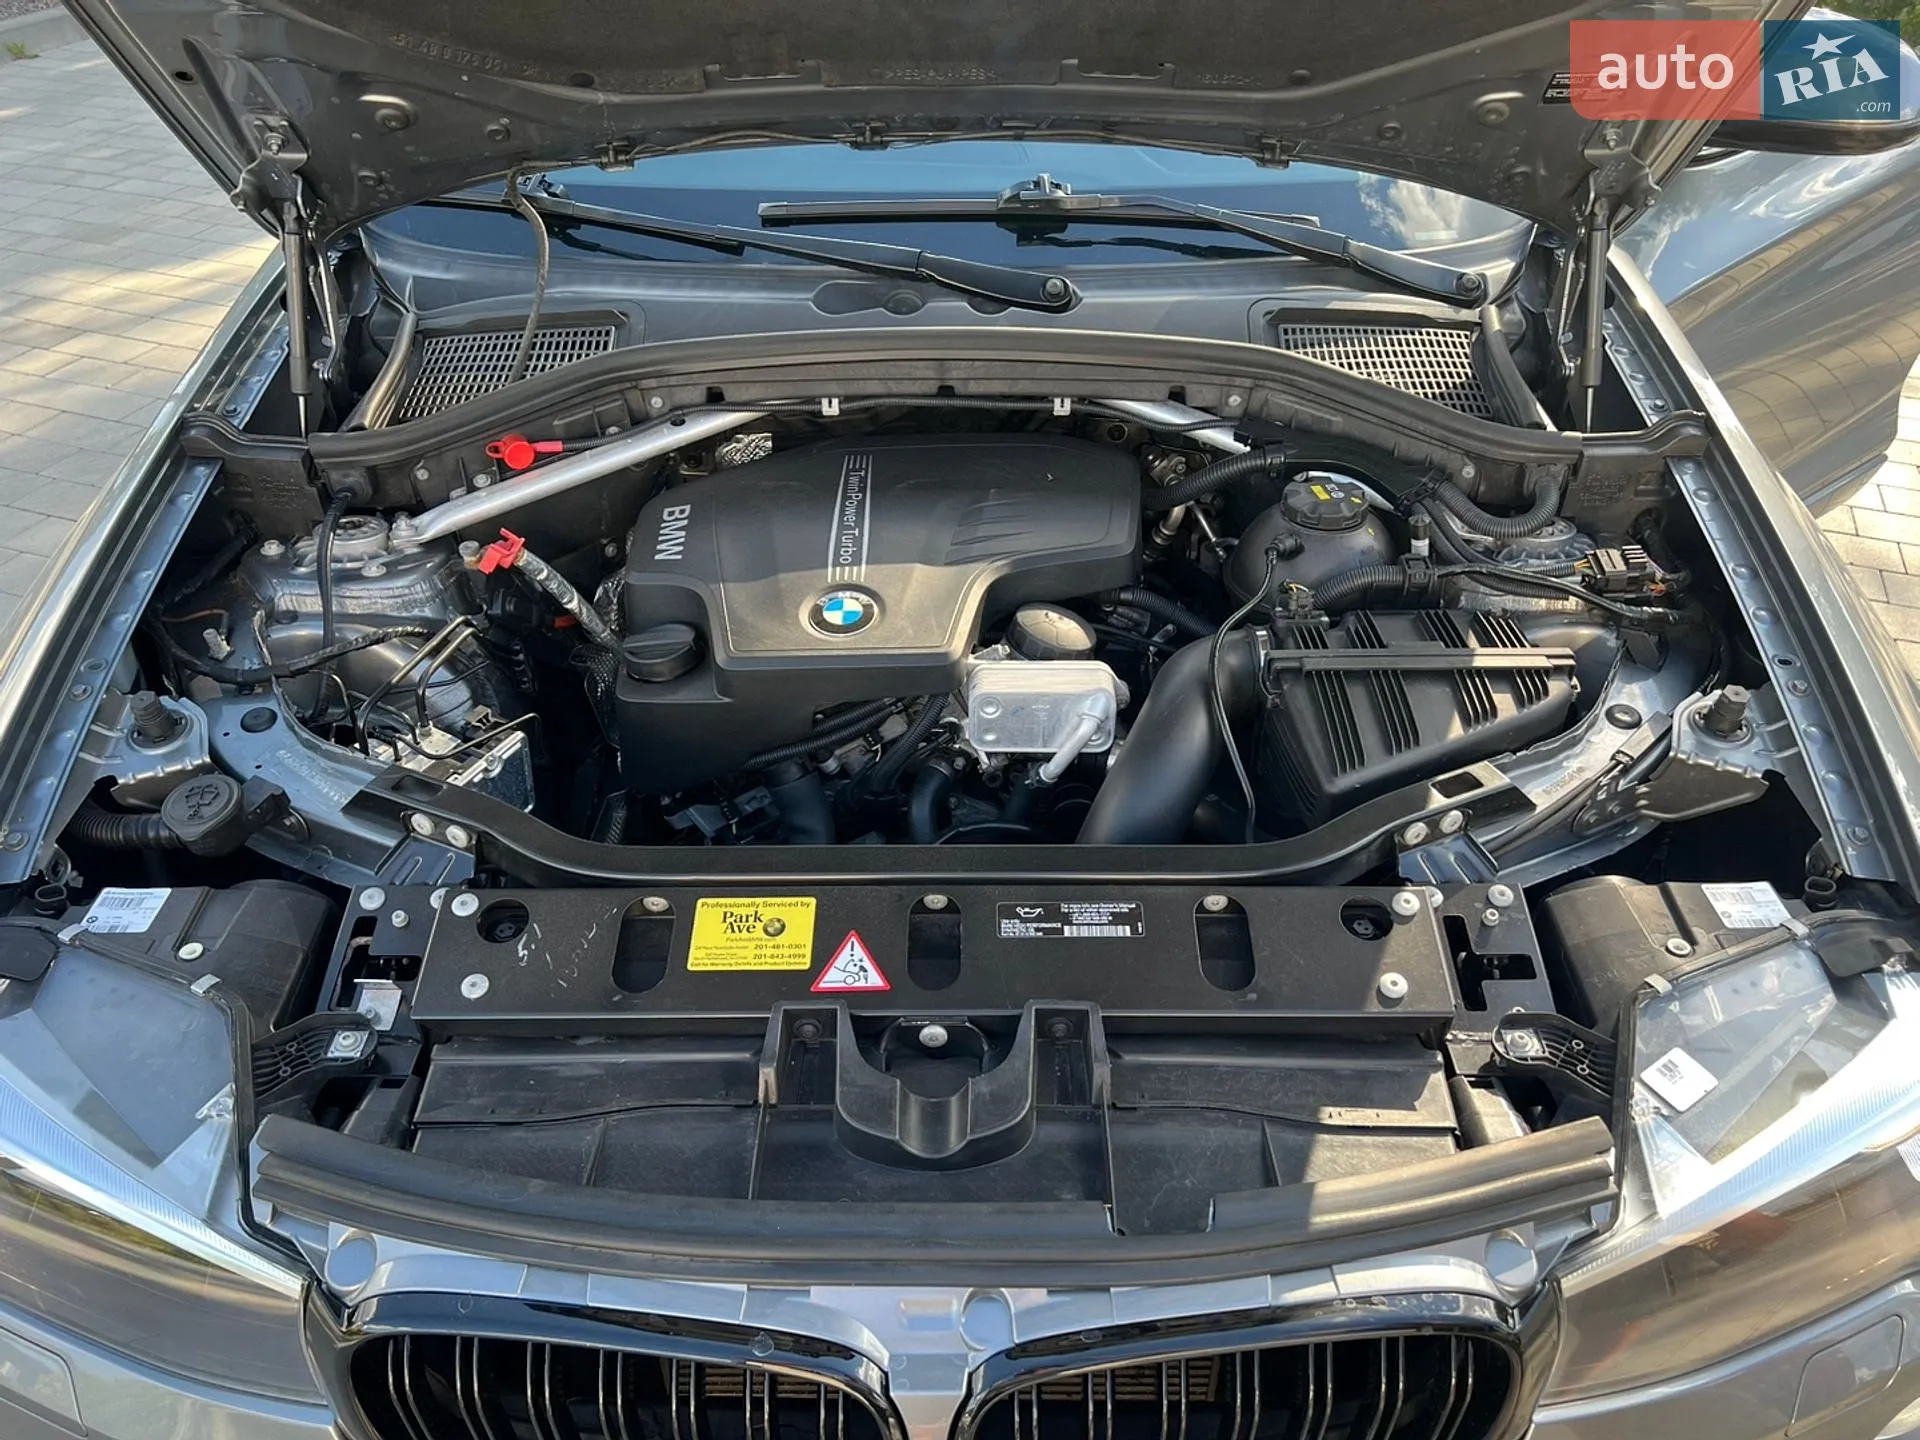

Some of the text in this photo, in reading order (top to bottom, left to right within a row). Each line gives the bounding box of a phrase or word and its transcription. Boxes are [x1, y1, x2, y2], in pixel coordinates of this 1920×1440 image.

[839, 469, 865, 565] TwinPower Turbo
[654, 504, 692, 560] BMW
[701, 900, 812, 911] Professionally Serviced by
[722, 910, 765, 924] Park
[723, 922, 757, 934] Ave
